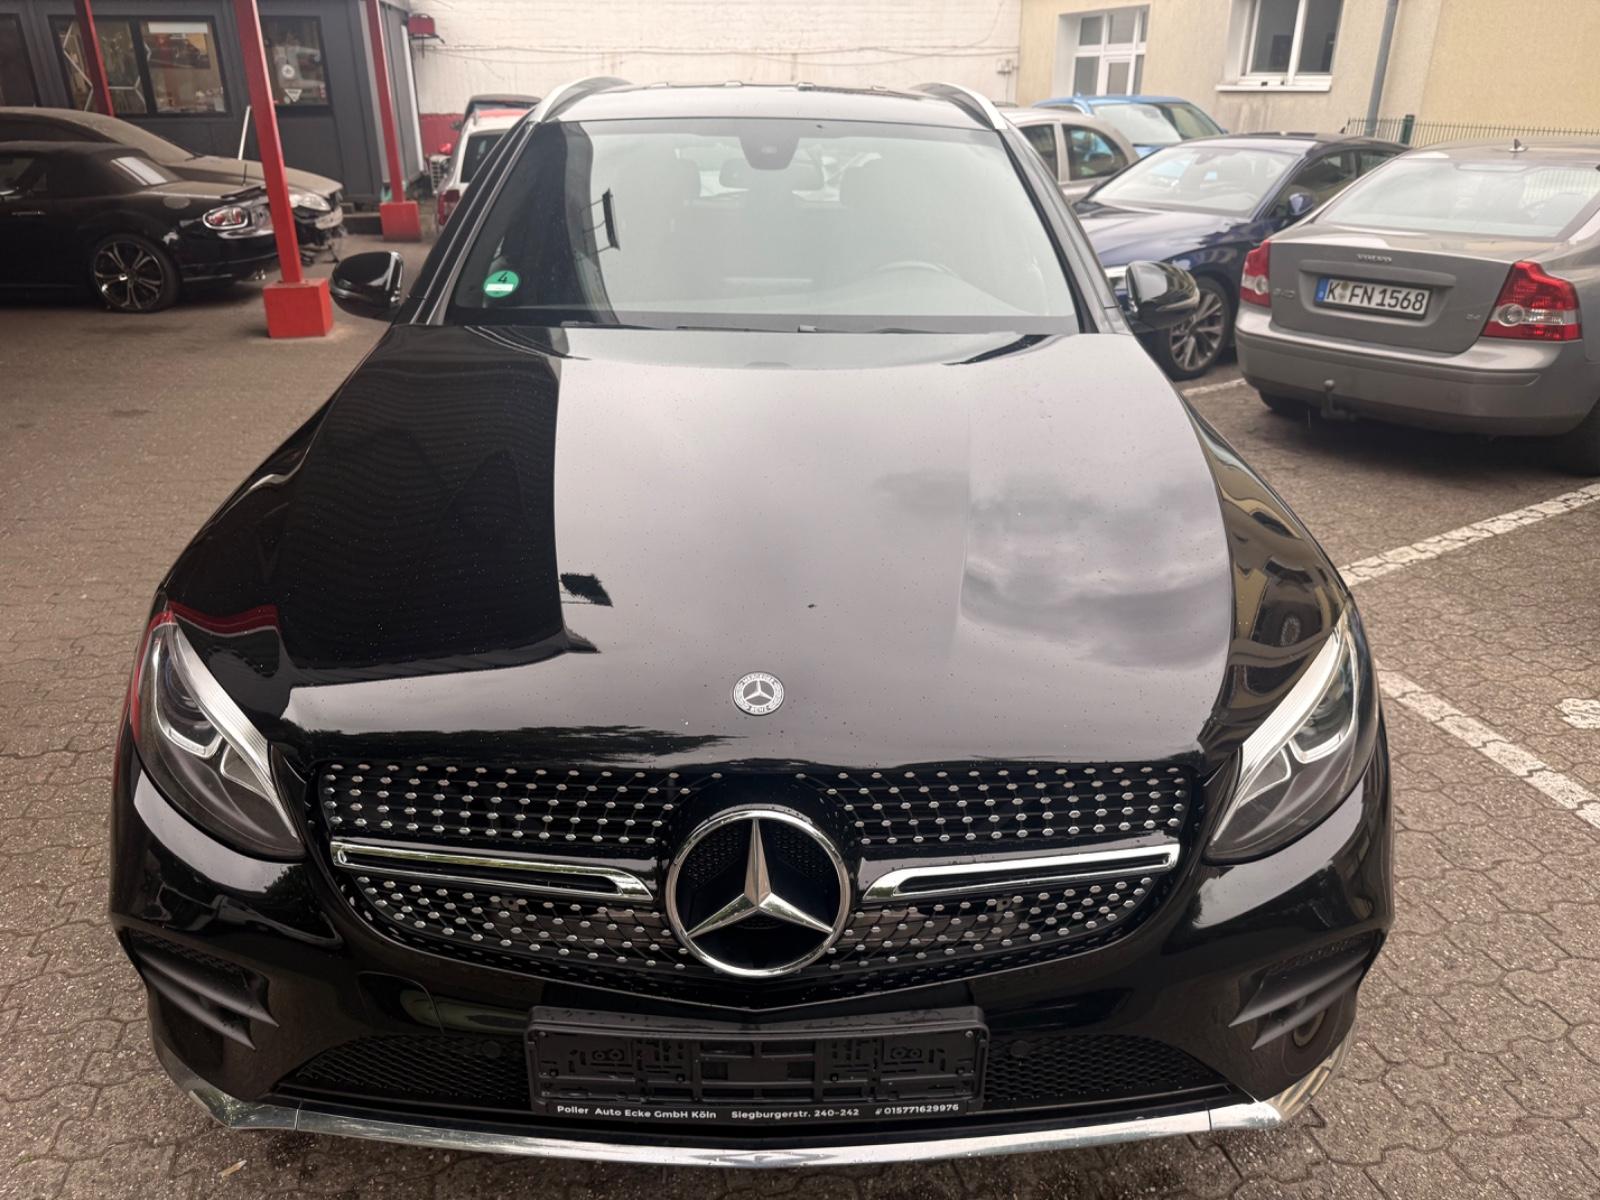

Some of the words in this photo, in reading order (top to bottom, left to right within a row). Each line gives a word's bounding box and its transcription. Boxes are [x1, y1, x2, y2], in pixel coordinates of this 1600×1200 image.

[497, 271, 508, 283] 4
[1325, 282, 1341, 301] K
[595, 1107, 622, 1116] Auto
[624, 1109, 651, 1118] Ecke
[653, 1110, 688, 1118] GmbH
[691, 1110, 717, 1119] Köln
[731, 1110, 811, 1120] Siegburgerstr.
[813, 1108, 860, 1118] 240-242
